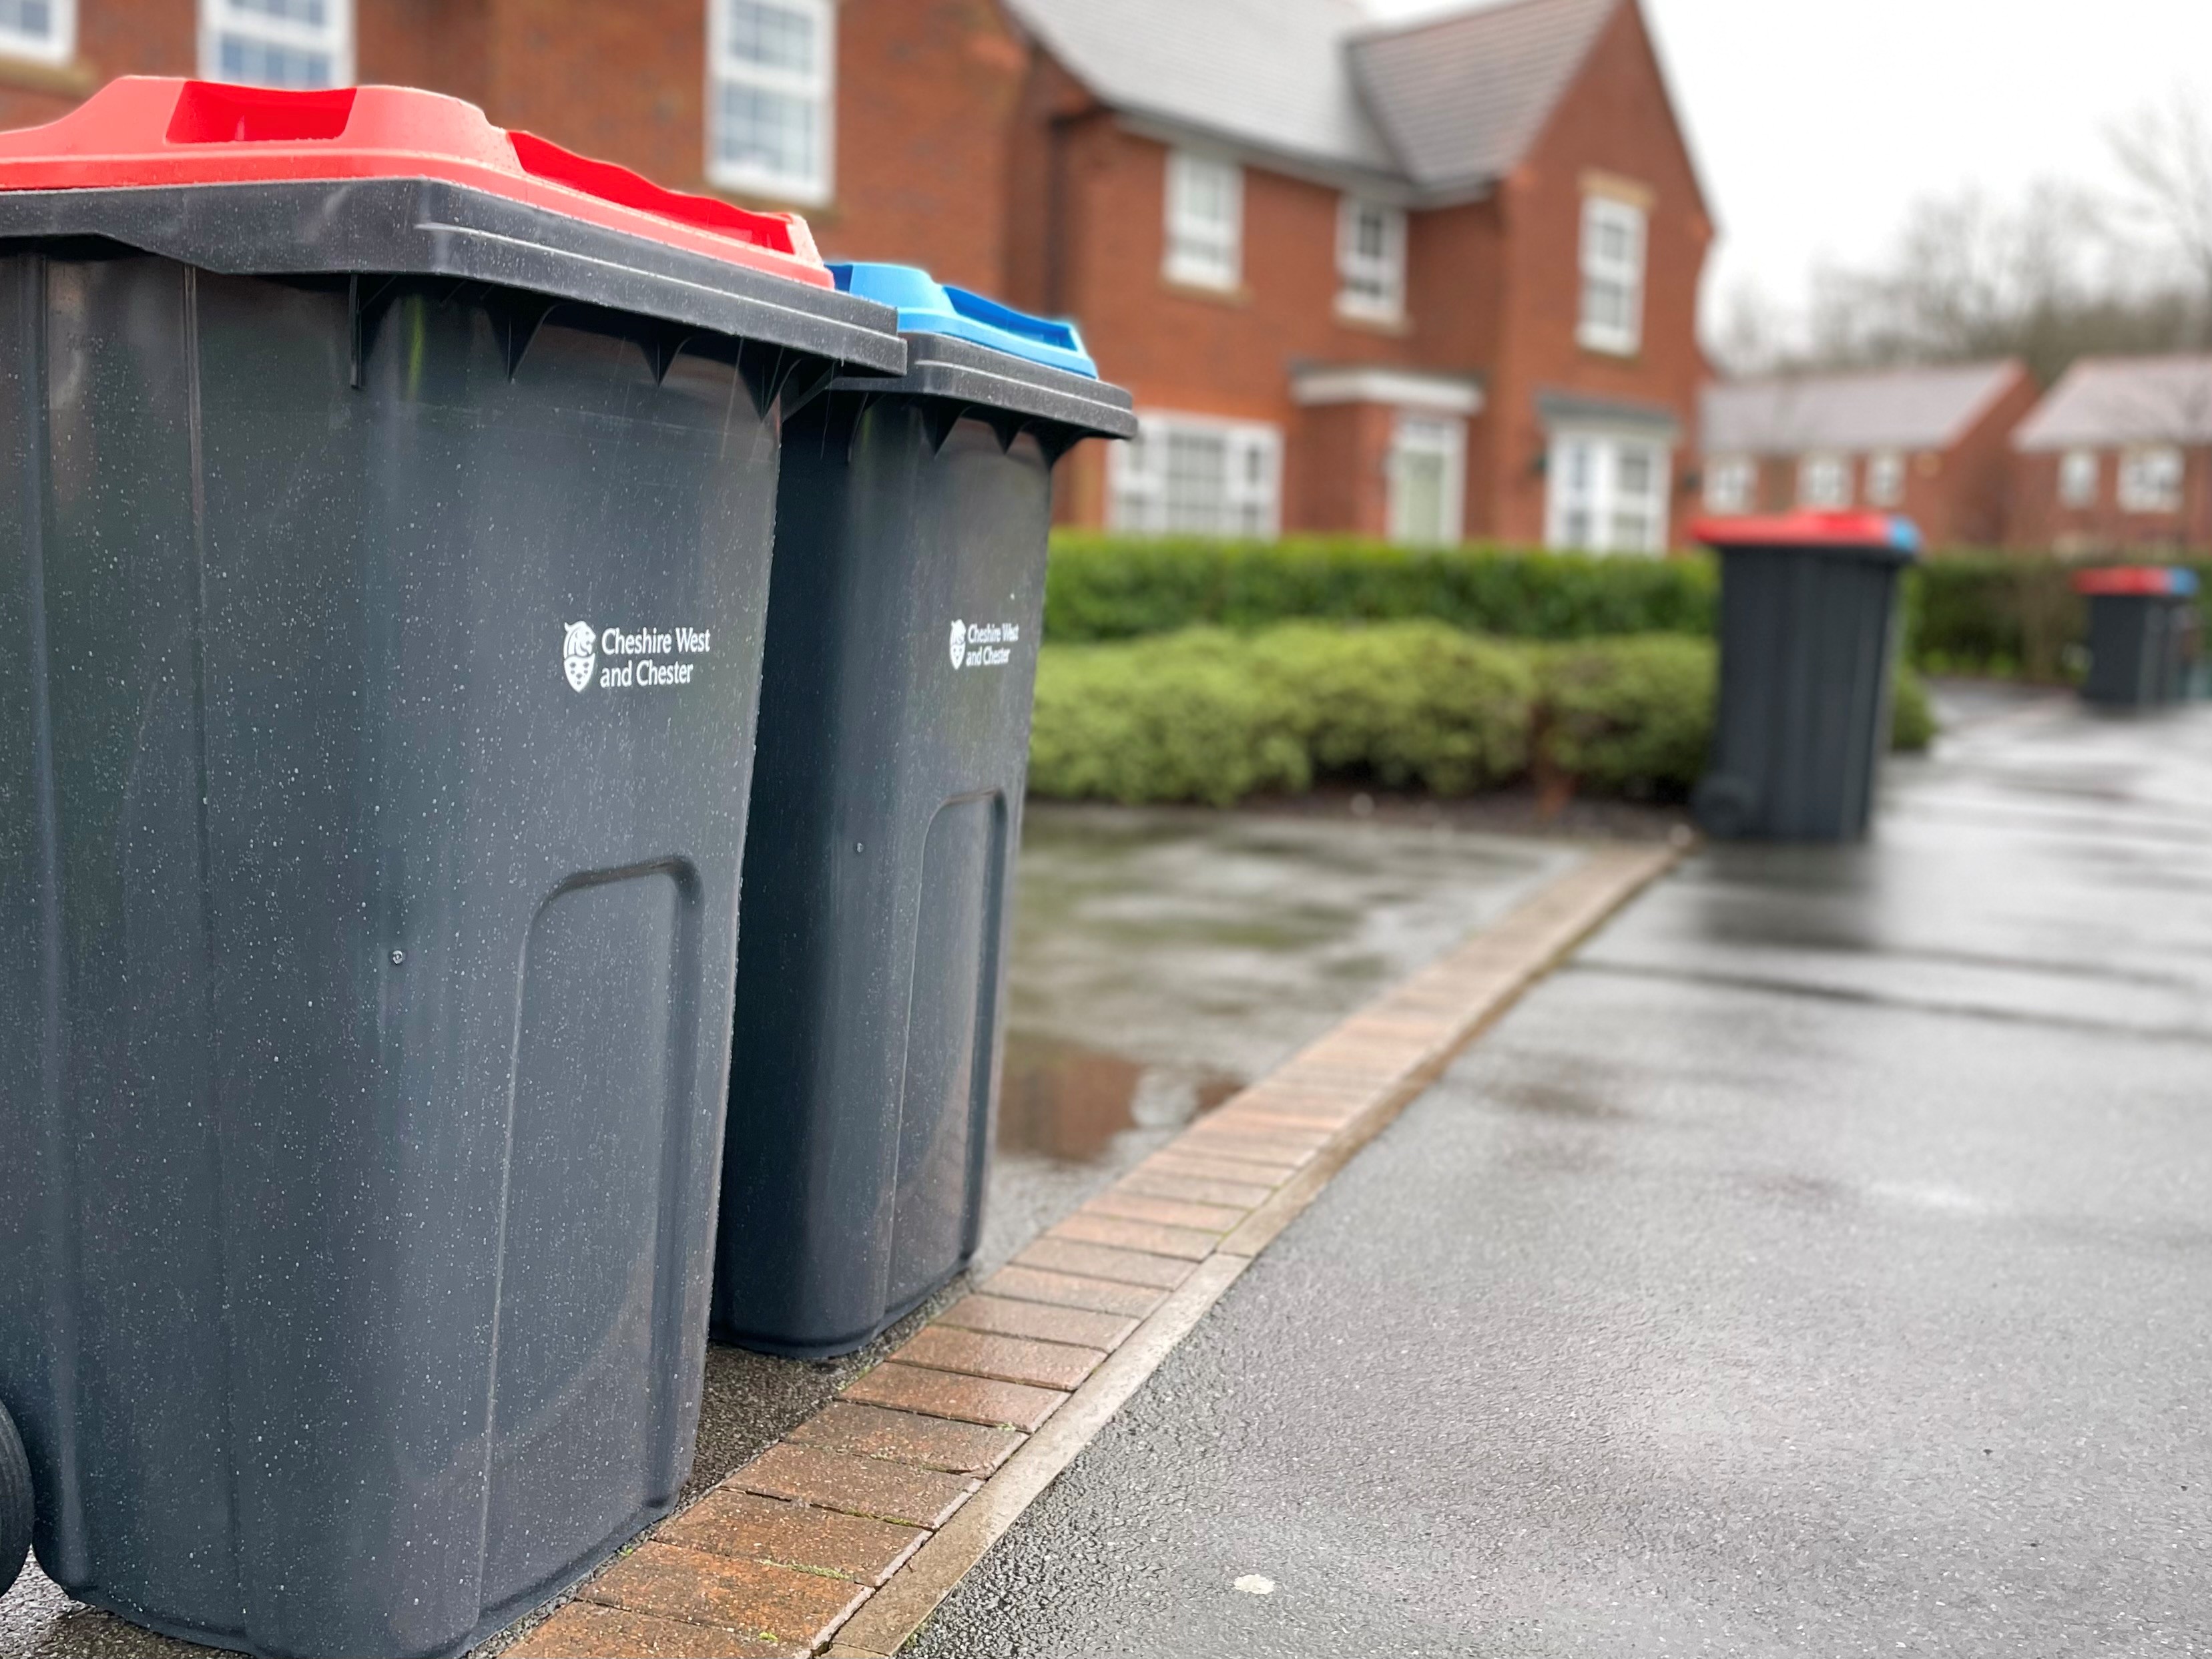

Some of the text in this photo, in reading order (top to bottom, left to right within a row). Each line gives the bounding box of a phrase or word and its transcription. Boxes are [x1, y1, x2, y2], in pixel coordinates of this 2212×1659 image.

[601, 627, 710, 655] Cheshire West
[967, 623, 1019, 644] Cheshire West
[966, 646, 1011, 666] and Chester
[600, 659, 694, 688] and Chester
